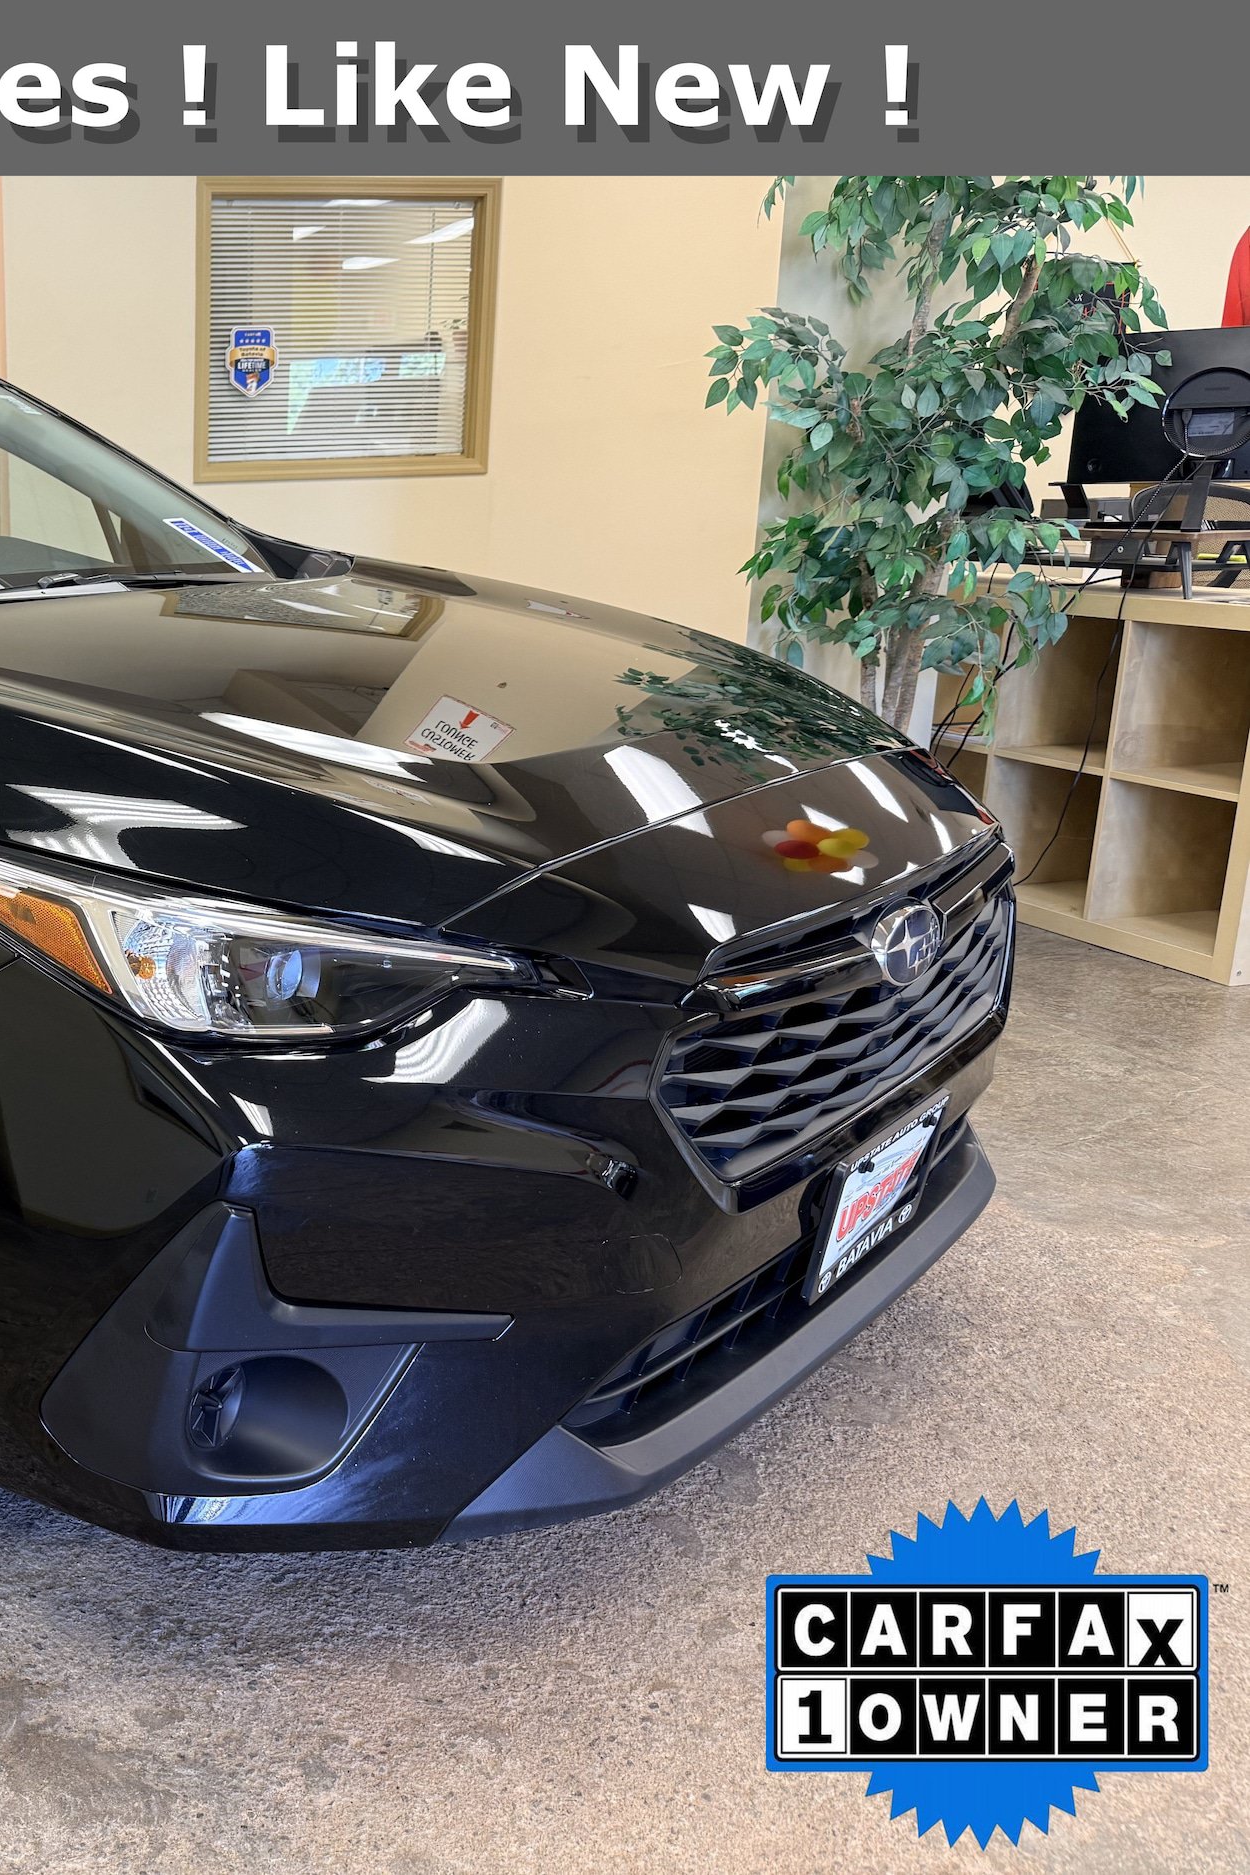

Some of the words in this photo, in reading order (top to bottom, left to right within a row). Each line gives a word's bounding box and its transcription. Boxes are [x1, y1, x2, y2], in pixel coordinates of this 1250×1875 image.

[237, 361, 267, 370] LIFETIME
[891, 1118, 919, 1142] AUTO
[919, 1095, 950, 1122] GROUP
[836, 1217, 893, 1279] BATAVIA
